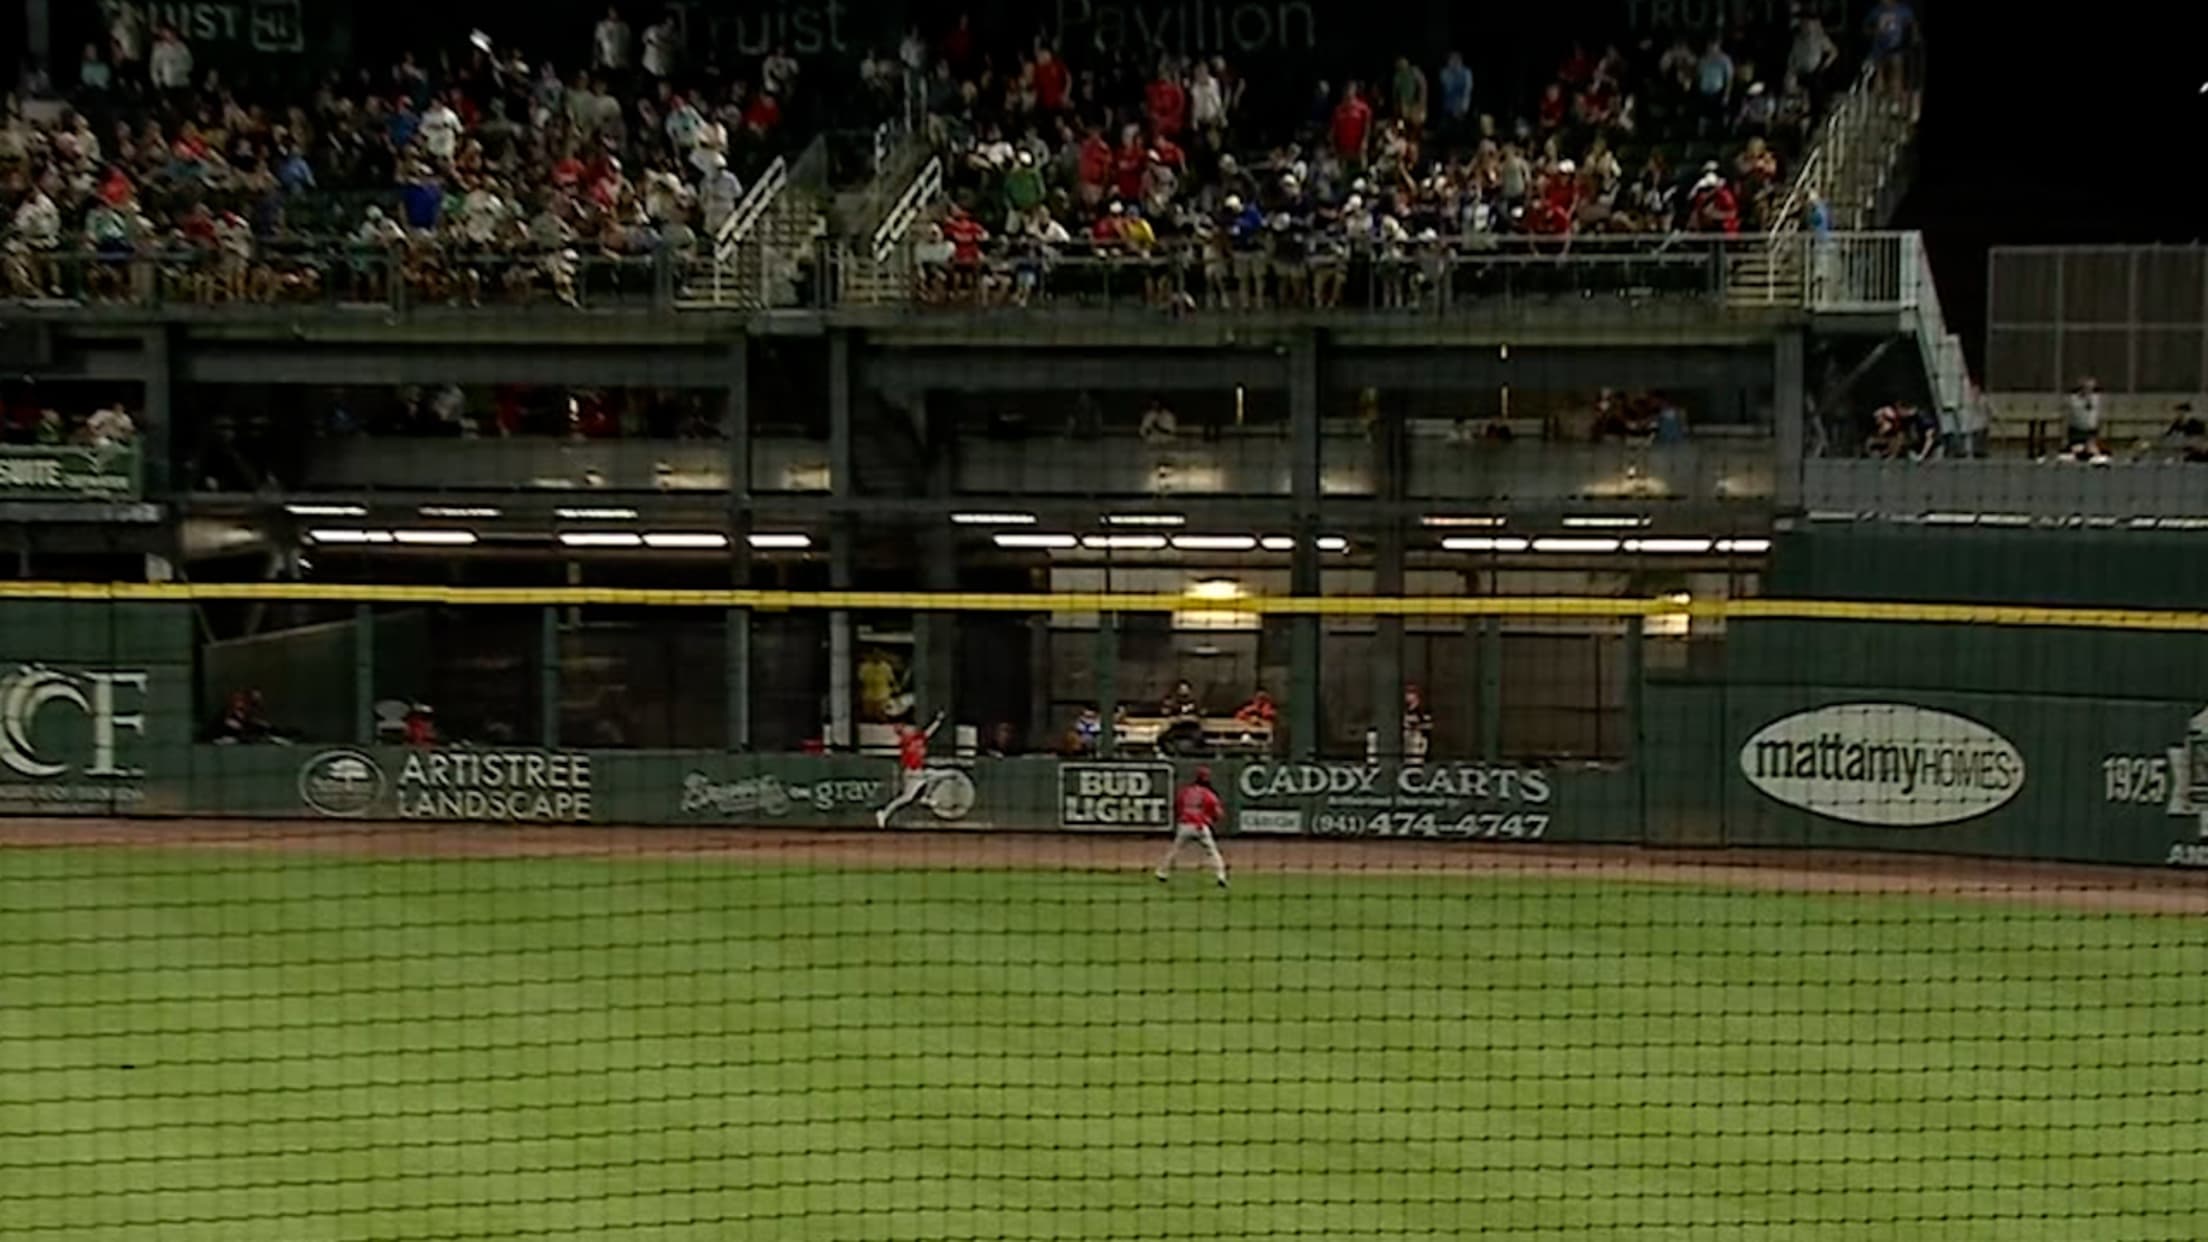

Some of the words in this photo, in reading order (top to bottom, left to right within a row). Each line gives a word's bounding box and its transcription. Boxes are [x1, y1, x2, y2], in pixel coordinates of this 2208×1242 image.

[400, 752, 591, 789] ARTISTREE
[1080, 770, 1152, 797] BUD
[1240, 763, 1382, 798] CADDY
[1396, 768, 1550, 803] CARTS
[2102, 756, 2168, 803] 1925
[398, 790, 591, 820] LANDSCAPE
[1066, 797, 1167, 822] LIGHT
[1369, 811, 1550, 839] 474-4747
